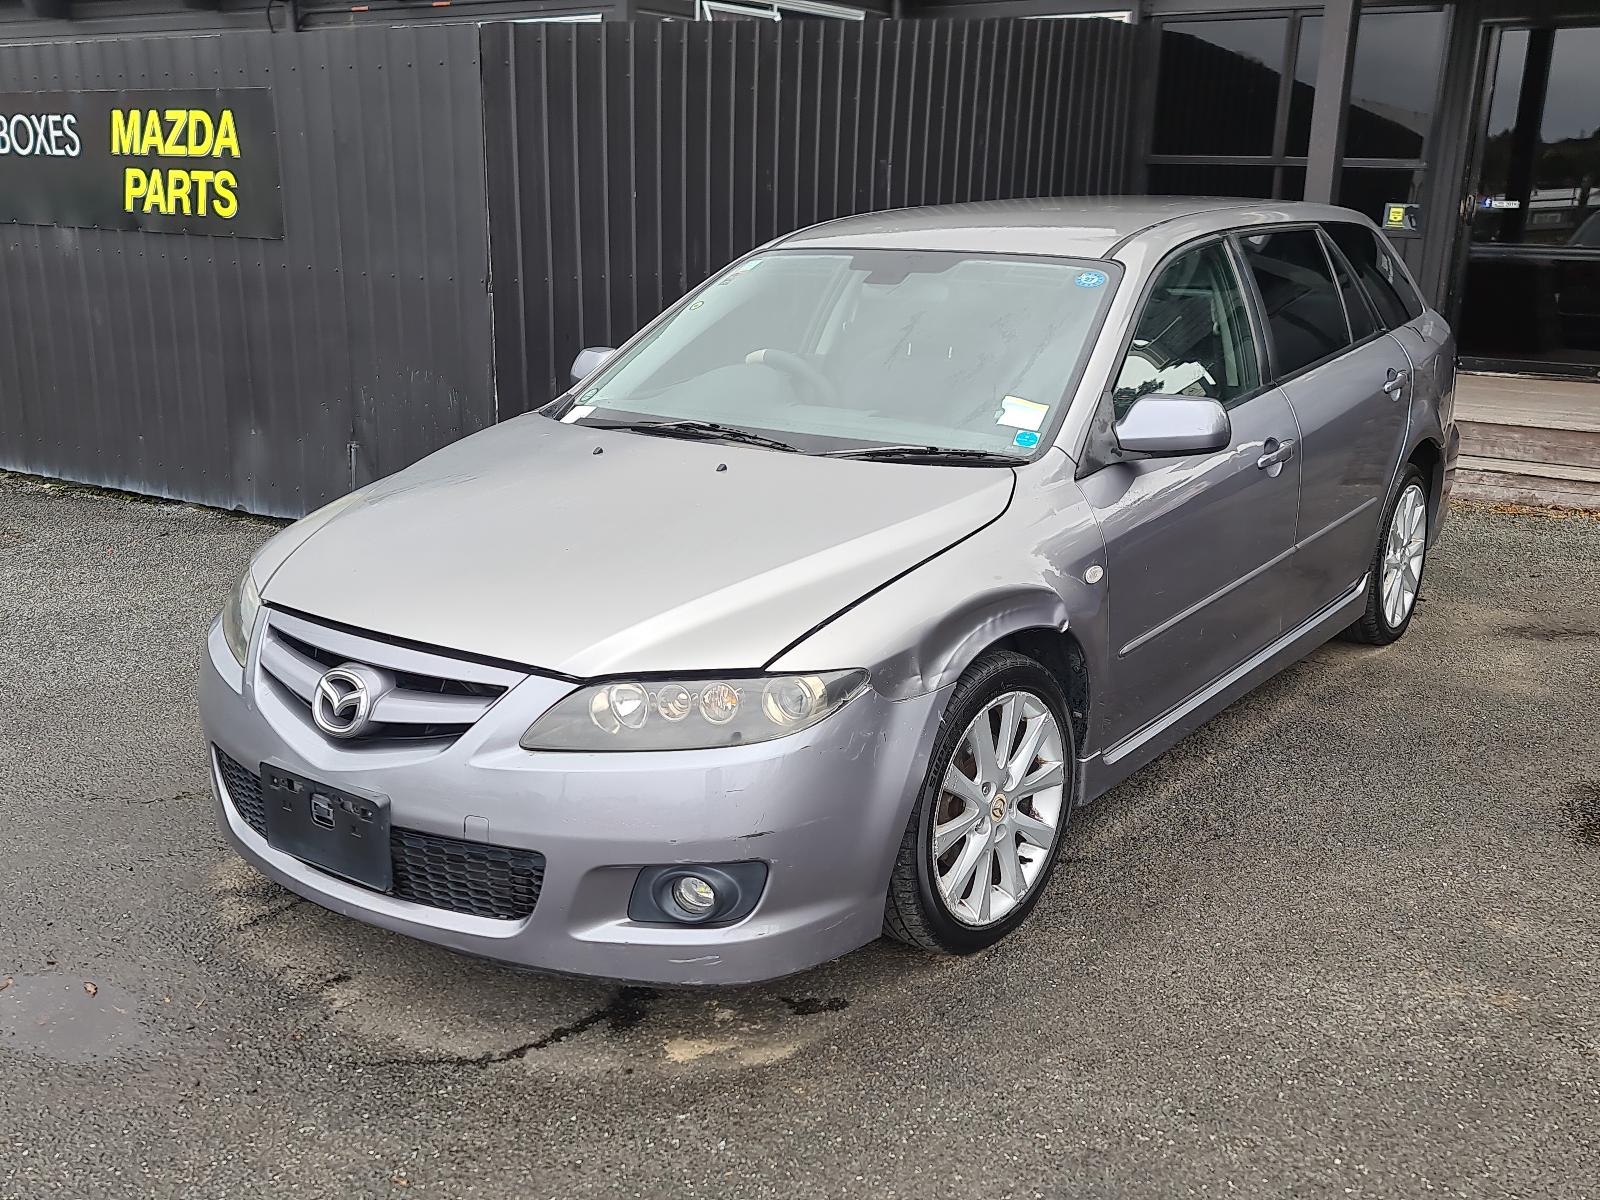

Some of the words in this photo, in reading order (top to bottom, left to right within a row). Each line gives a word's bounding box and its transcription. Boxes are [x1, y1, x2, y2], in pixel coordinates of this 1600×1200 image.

[0, 113, 81, 157] BOXES
[110, 109, 241, 158] MAZDA
[123, 167, 238, 219] PARTS
